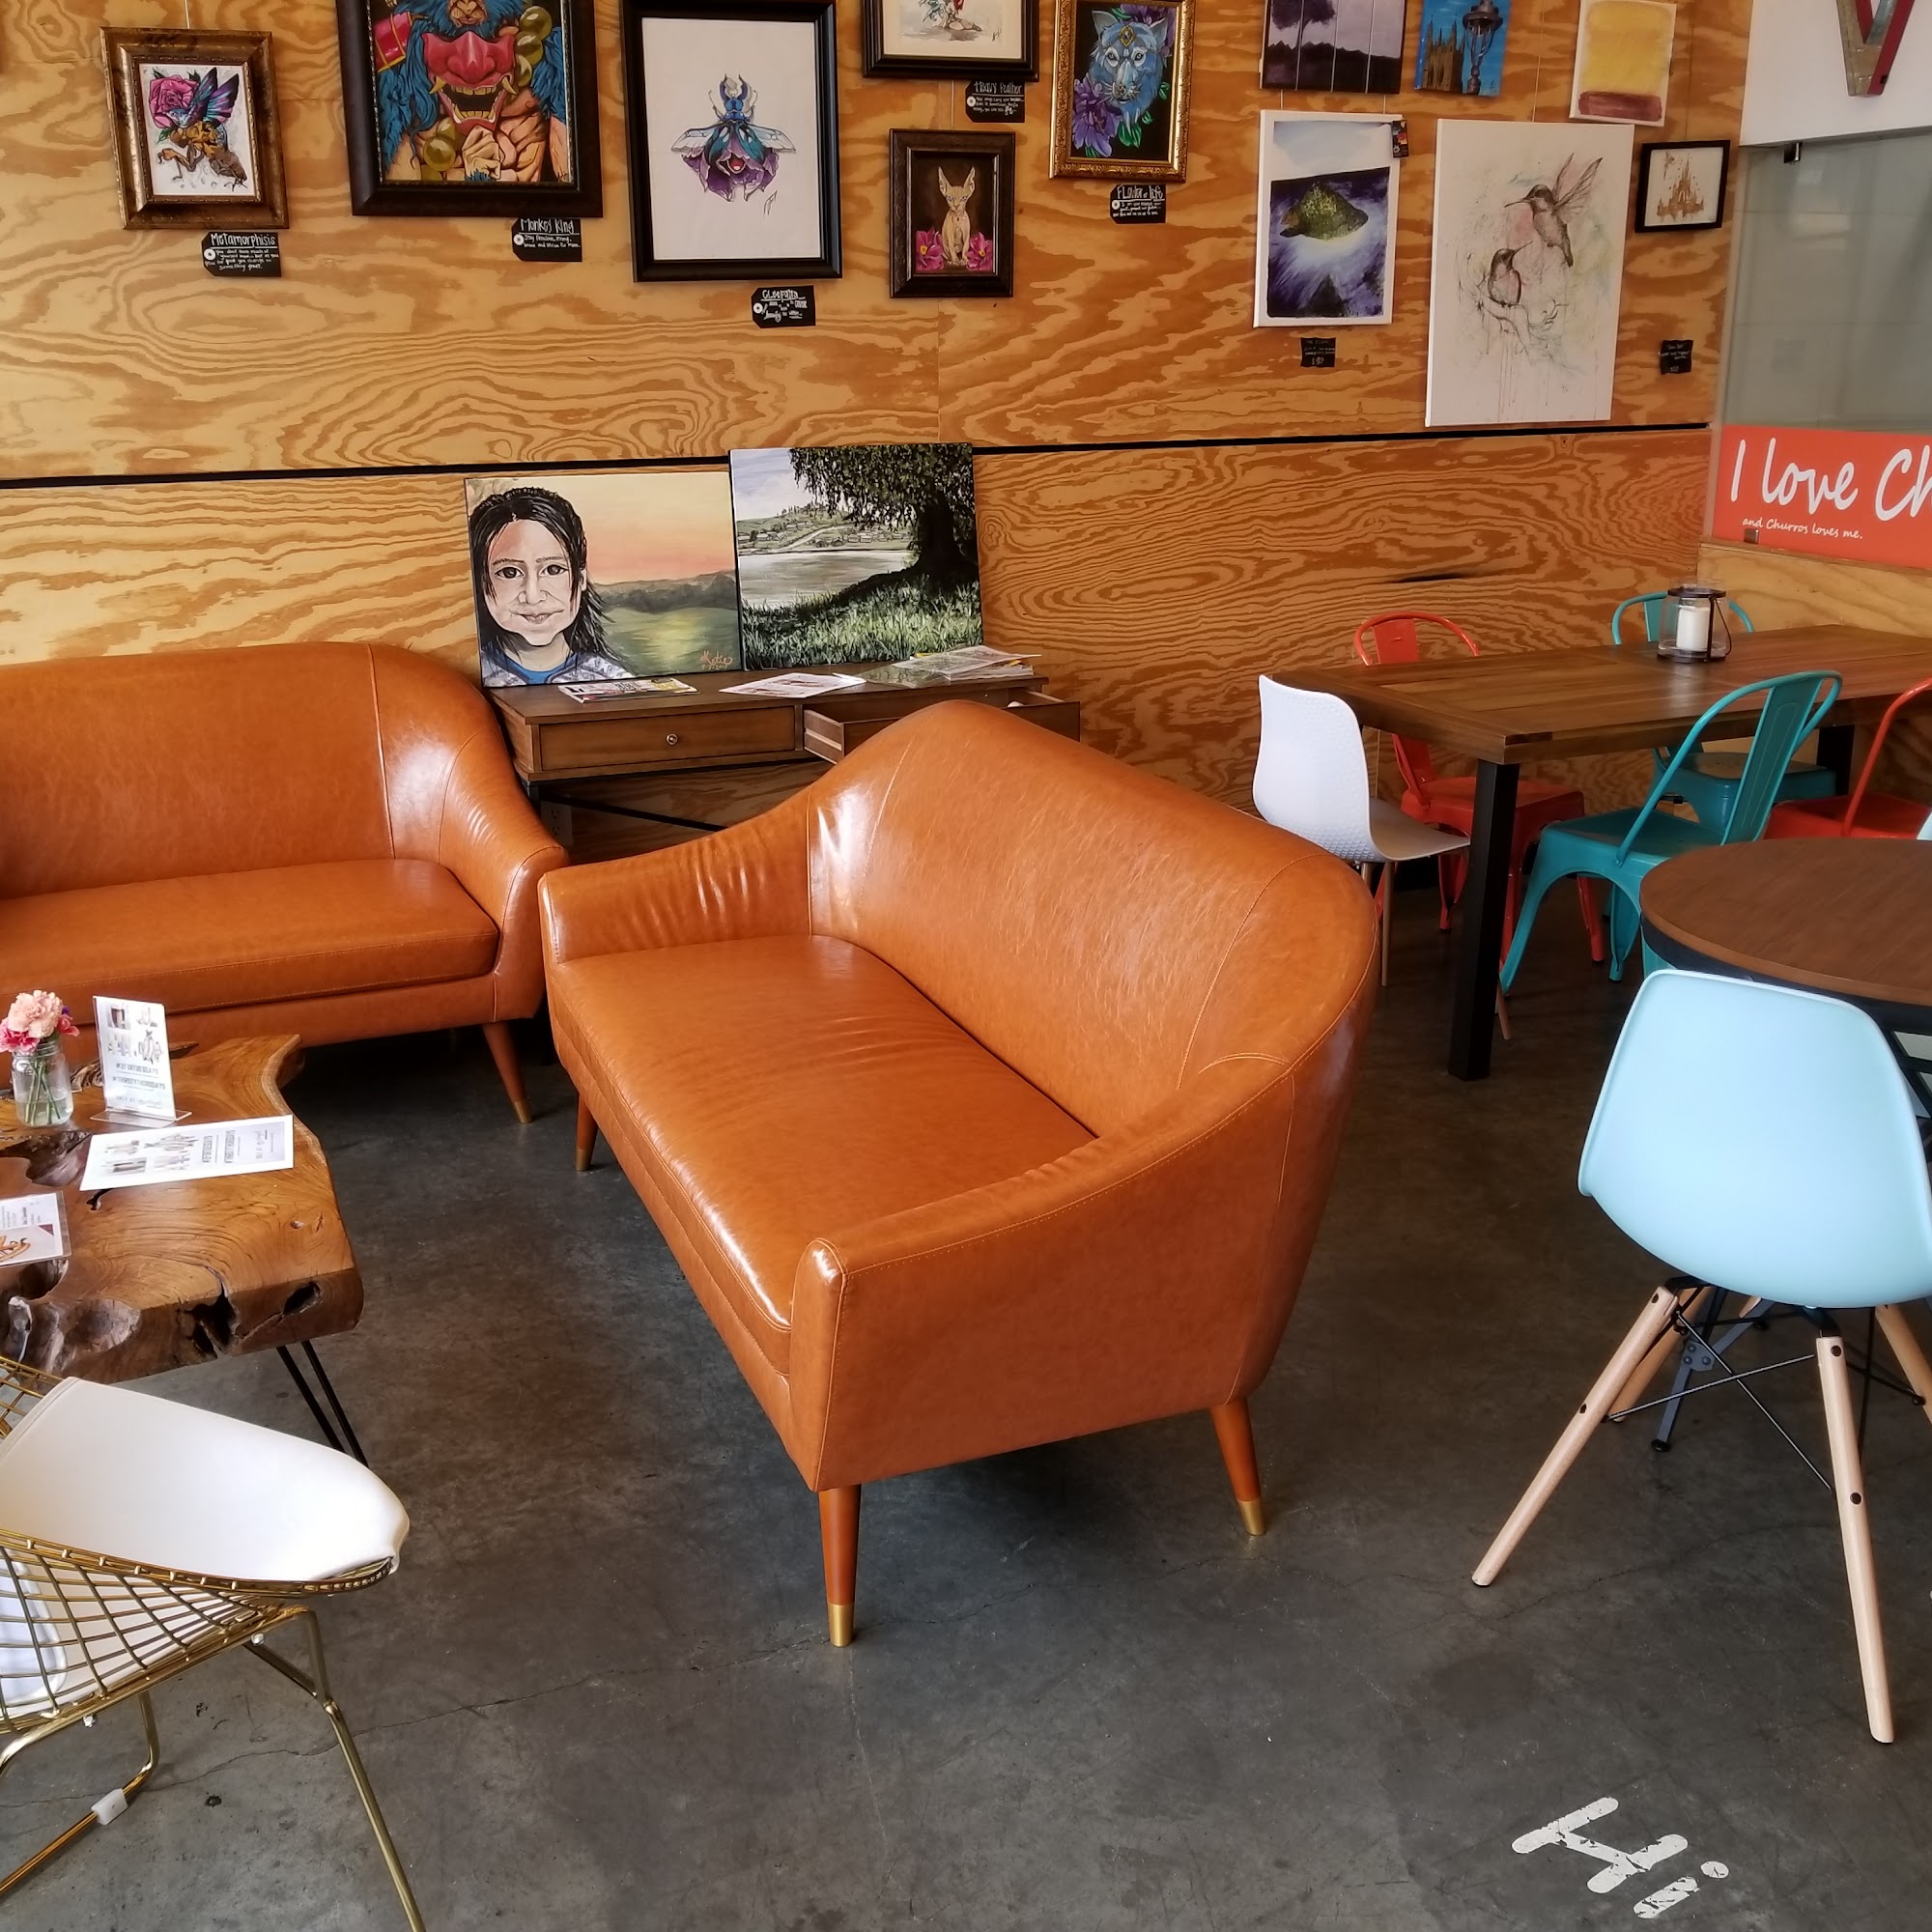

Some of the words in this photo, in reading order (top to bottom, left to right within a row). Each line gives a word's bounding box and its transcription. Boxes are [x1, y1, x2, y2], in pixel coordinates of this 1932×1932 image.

[520, 217, 553, 234] Monkey
[210, 232, 276, 247] Metamorphisis
[1731, 439, 1747, 502] I
[1761, 437, 1859, 515] love
[1742, 517, 1764, 528] and
[1766, 518, 1809, 534] Churros
[1811, 523, 1839, 538] loves
[1842, 529, 1863, 540] me.
[1511, 1797, 1729, 1918] Hi
